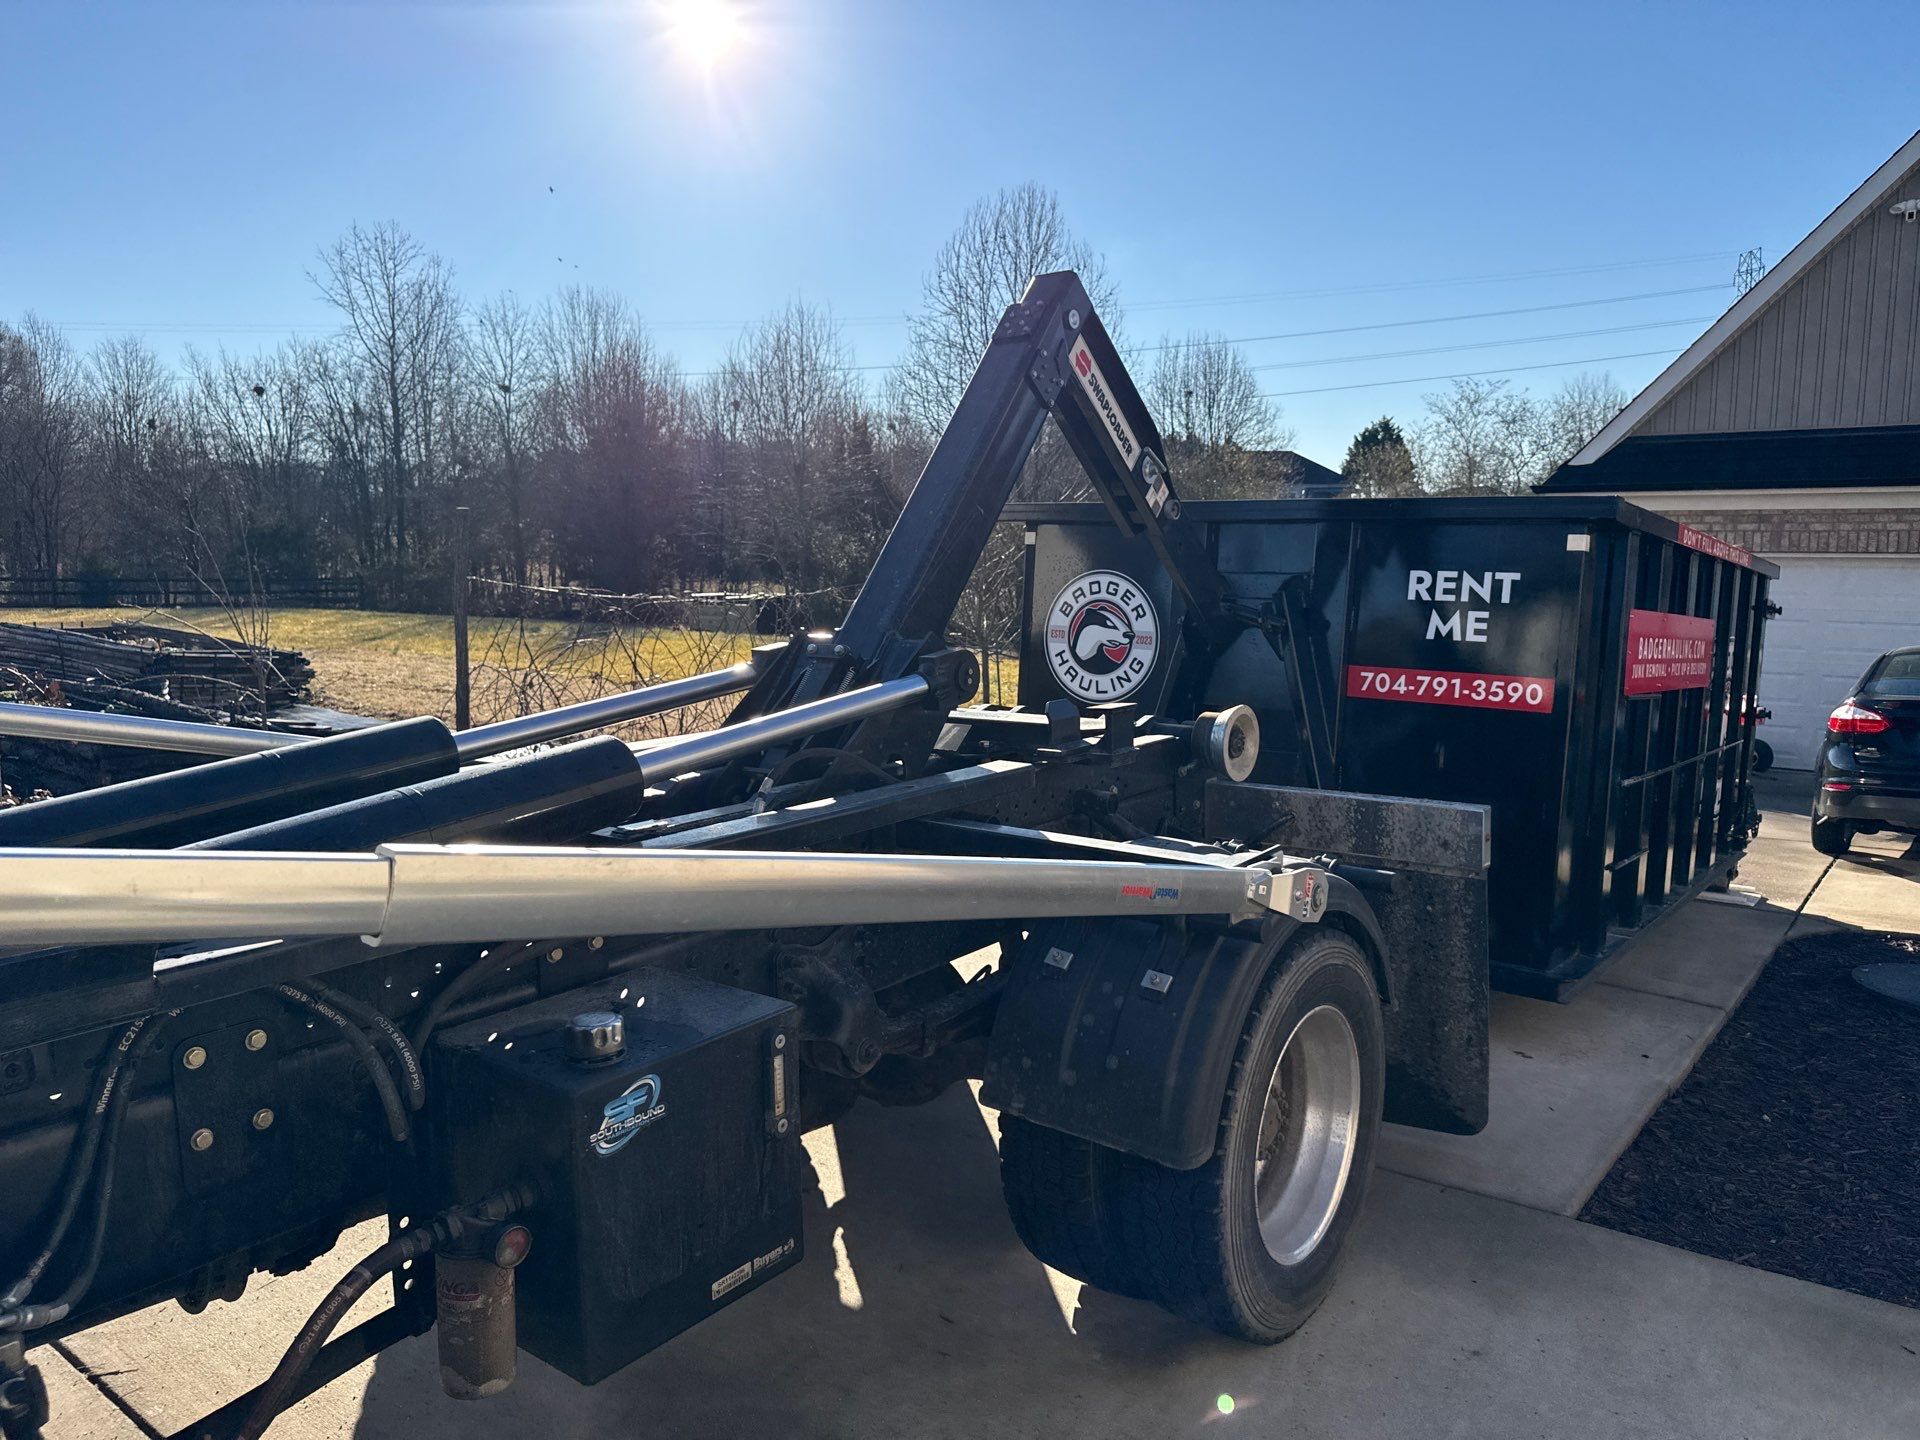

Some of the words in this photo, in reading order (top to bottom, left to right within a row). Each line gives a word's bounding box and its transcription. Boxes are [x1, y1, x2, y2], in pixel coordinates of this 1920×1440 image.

[1088, 373, 1134, 458] SWAPLOADER
[1059, 580, 1147, 622] BADGER
[1407, 569, 1522, 604] RENT
[1050, 628, 1066, 640] ESTD
[1135, 635, 1153, 646] 2023
[1425, 608, 1490, 643] ME
[1638, 636, 1706, 661] BADGERHAULING.COM
[1055, 649, 1144, 694] HAULING
[1359, 671, 1544, 706] 704-791-3590
[381, 1021, 394, 1035] 275
[391, 1032, 406, 1050] BAR
[401, 1048, 416, 1073] (4000
[590, 1104, 666, 1143] SOUTHBOUND
[313, 1313, 329, 1331] BAR
